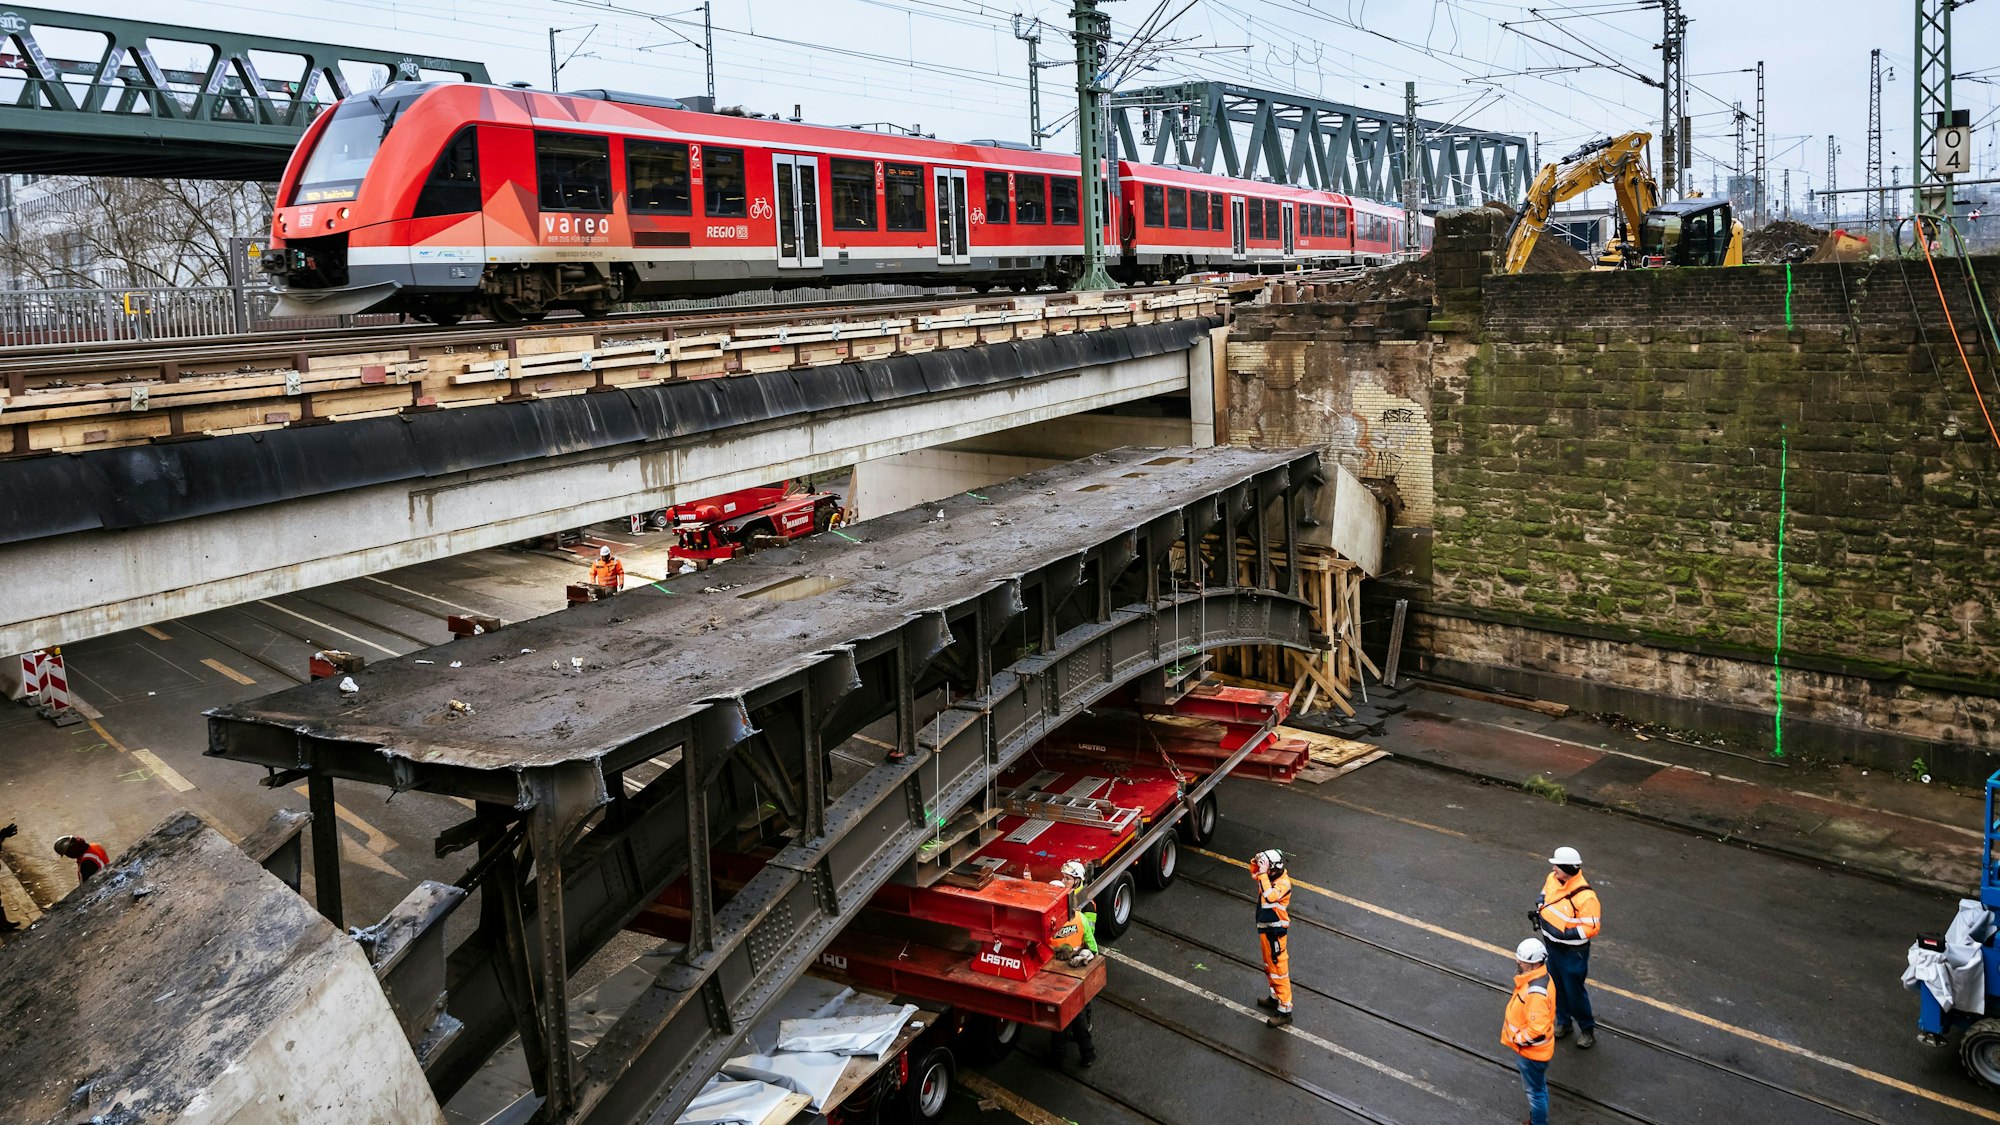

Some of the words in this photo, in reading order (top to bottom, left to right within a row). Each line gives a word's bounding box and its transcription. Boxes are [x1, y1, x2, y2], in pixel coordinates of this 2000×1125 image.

[691, 145, 699, 161] 2
[1945, 150, 1960, 169] 4
[876, 162, 882, 175] 2
[544, 217, 609, 234] vareo
[706, 226, 735, 238] REGIO
[786, 515, 809, 529] MANITOU
[980, 951, 1021, 970] LASTRO
